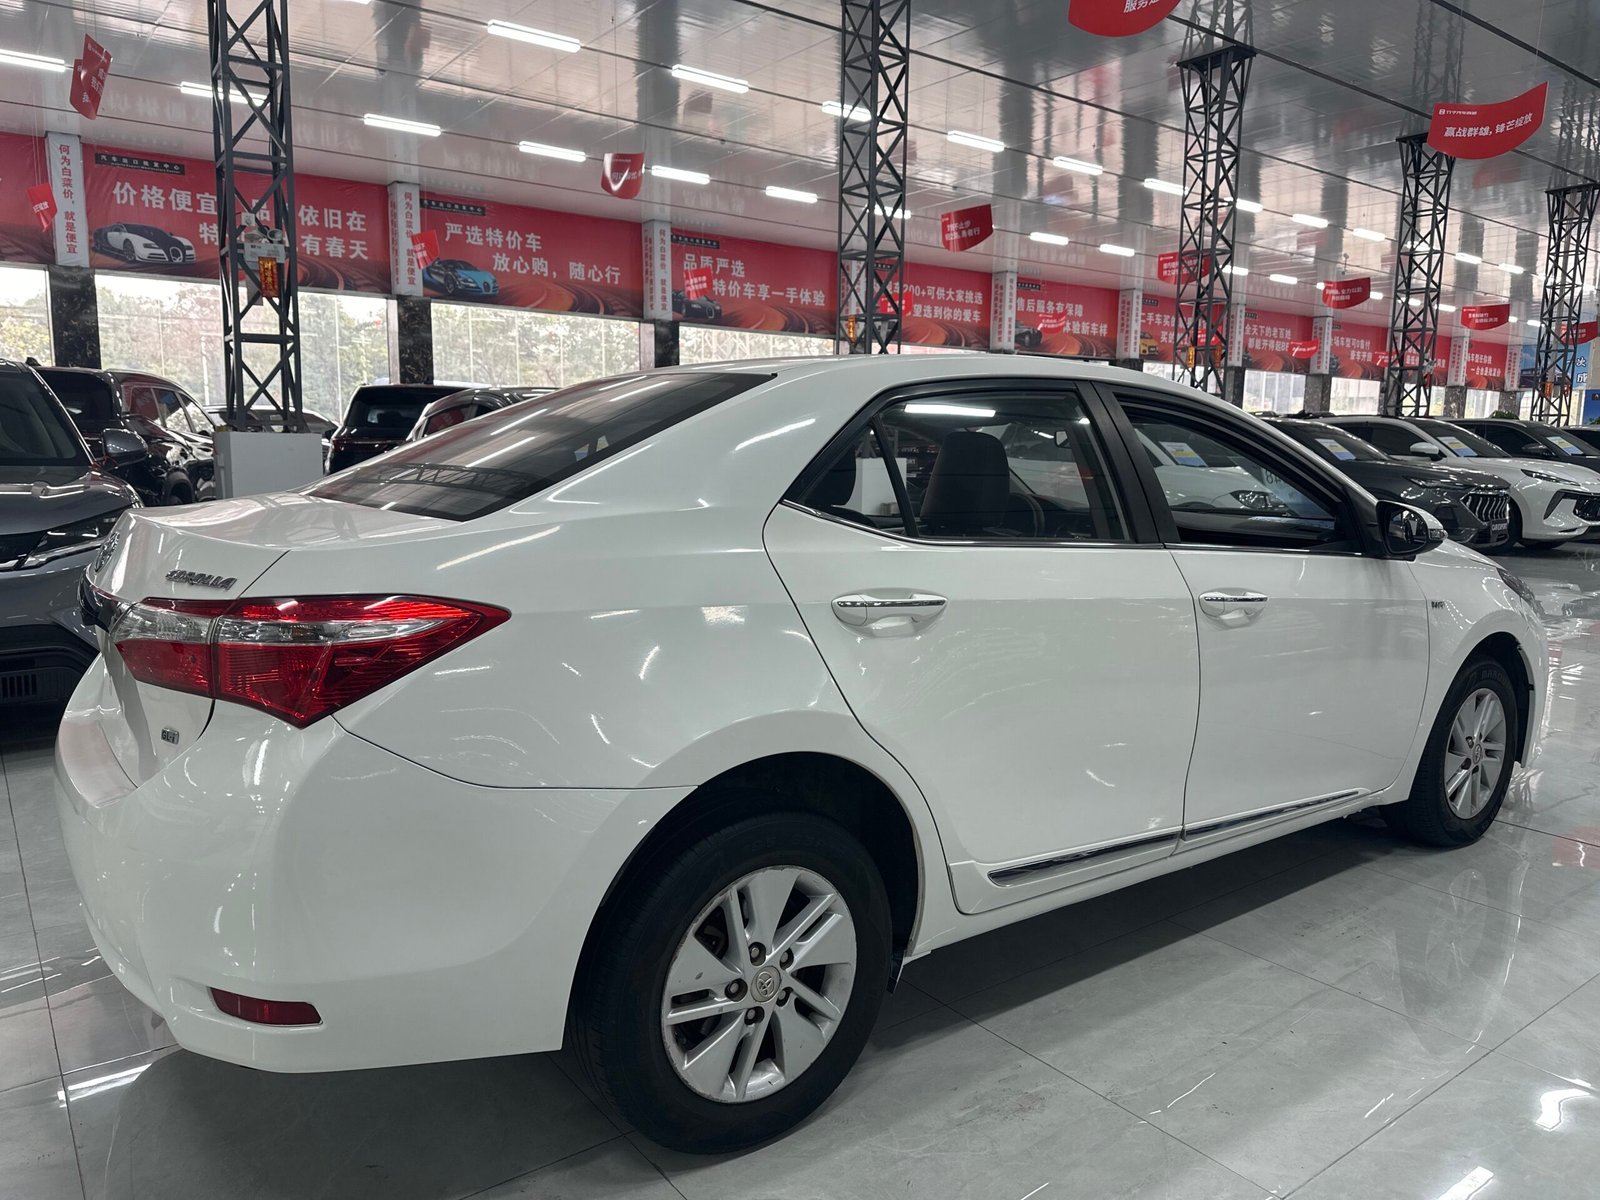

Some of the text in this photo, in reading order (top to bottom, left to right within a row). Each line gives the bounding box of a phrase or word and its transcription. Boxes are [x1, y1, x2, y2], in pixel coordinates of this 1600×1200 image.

[444, 222, 542, 251] 严选特价车
[492, 252, 621, 285] 放心购，随心行
[712, 278, 825, 306] 特价车享一手体验
[1017, 297, 1083, 317] 售后服务有保障
[1245, 324, 1292, 340] 全天下的老百姓
[165, 569, 238, 591] COROLLA
